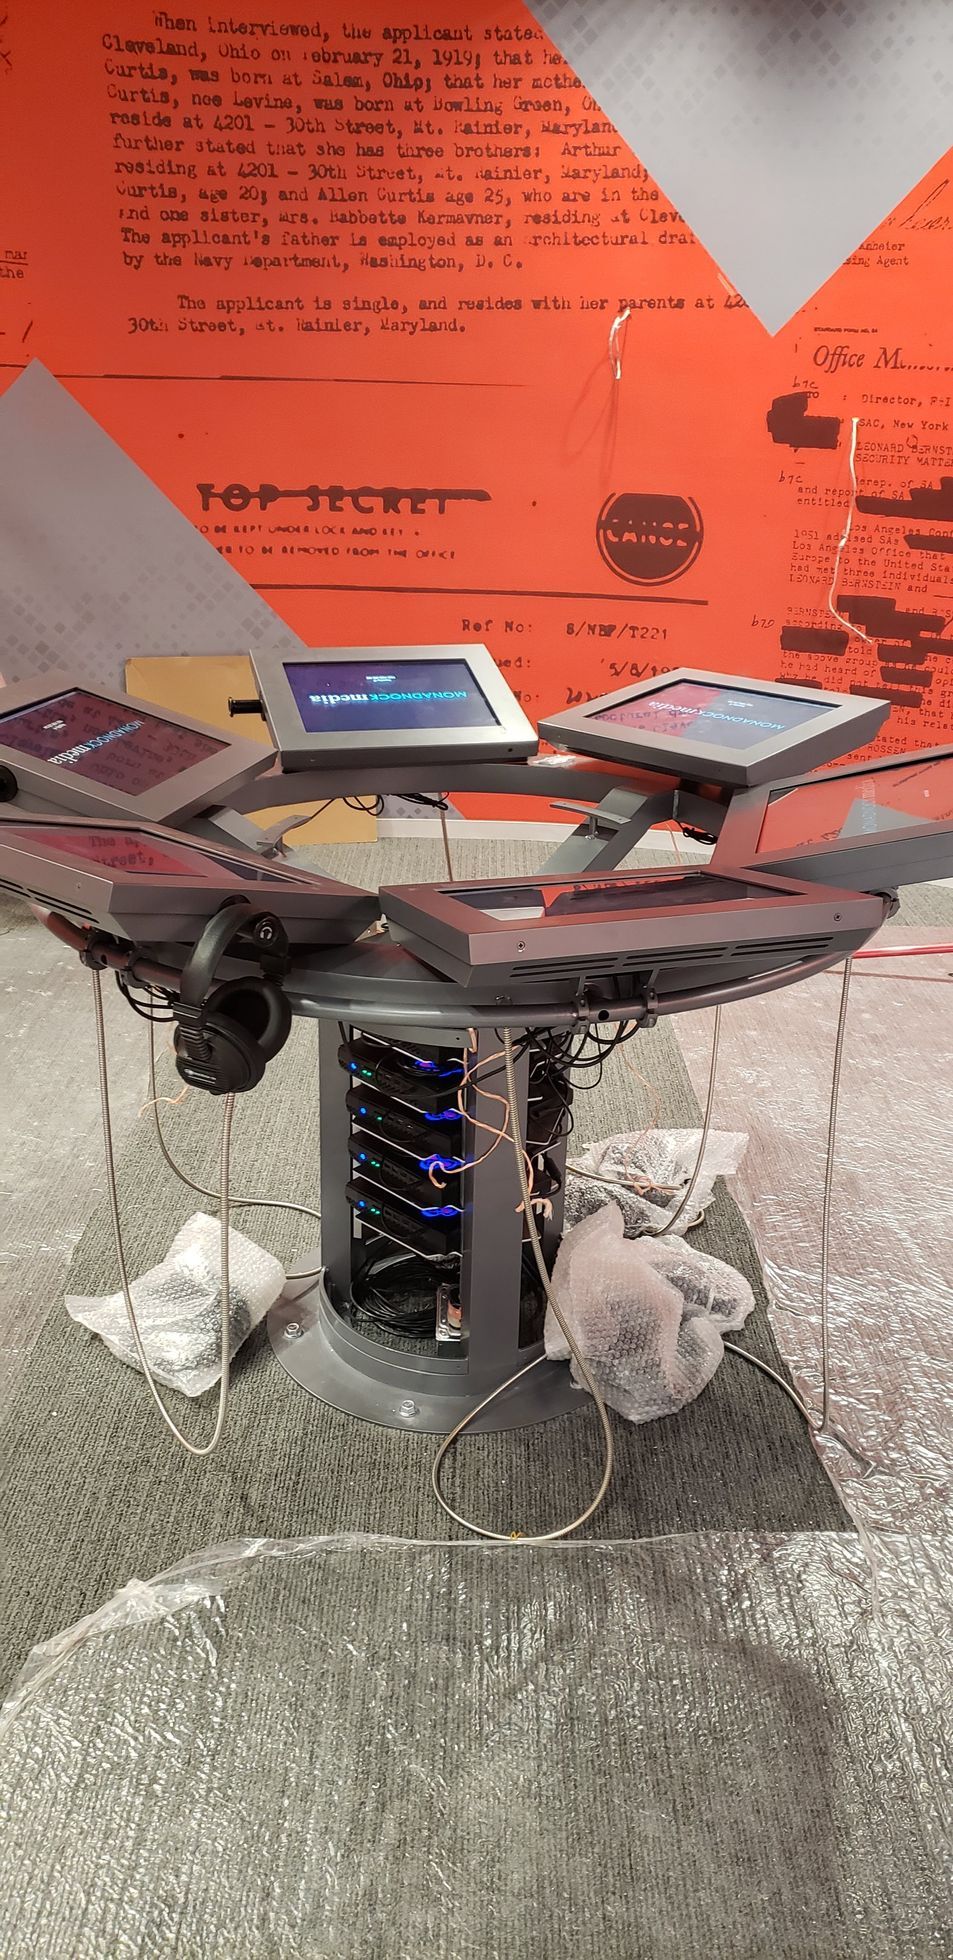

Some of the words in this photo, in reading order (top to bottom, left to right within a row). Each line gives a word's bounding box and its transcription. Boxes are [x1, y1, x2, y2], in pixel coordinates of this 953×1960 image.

[208, 16, 329, 43] interviewed,
[382, 24, 472, 44] applicant
[102, 34, 207, 63] Cleveland,
[219, 43, 261, 60] Ohio
[392, 48, 421, 70] 21,
[432, 49, 480, 70] 1919;
[493, 50, 533, 65] that
[104, 58, 177, 85] Curtis,
[188, 69, 219, 82] was
[231, 67, 272, 85] born
[282, 72, 302, 86] at
[312, 70, 371, 92] Salem,
[444, 73, 484, 89] that
[493, 73, 523, 89] her
[107, 84, 179, 109] Curtis,
[233, 91, 302, 114] Levine,
[313, 99, 343, 111] was
[354, 96, 394, 112] born
[404, 97, 424, 113] at
[433, 96, 503, 116] Bowling
[514, 96, 570, 116] Green,
[109, 111, 171, 127] reside
[183, 114, 203, 130] at
[213, 114, 255, 132] 4201
[286, 117, 326, 134] 30th
[335, 119, 402, 139] Street,
[113, 133, 184, 152] further
[196, 138, 256, 155] stated
[267, 141, 306, 156] that
[316, 141, 345, 156] she
[356, 142, 384, 157] has
[397, 143, 444, 158] three
[453, 143, 539, 158] brothers:
[561, 142, 621, 157] Arthur
[114, 159, 197, 179] residing
[207, 161, 226, 177] at
[237, 162, 279, 179] 4201
[308, 164, 347, 180] 30th
[357, 165, 423, 184] Street,
[116, 181, 186, 203] Curtis,
[239, 185, 267, 206] 20;
[278, 187, 308, 201] and
[318, 187, 368, 202] Allen
[377, 187, 435, 203] Curtis
[445, 192, 473, 206] age
[485, 188, 511, 207] 25,
[521, 188, 552, 202] who
[562, 191, 590, 202] are
[601, 188, 621, 202] in
[631, 187, 659, 201] the
[200, 208, 268, 228] sister,
[524, 209, 600, 227] residing
[121, 227, 150, 244] The
[161, 229, 270, 248] applicant's
[281, 232, 339, 246] father
[349, 233, 367, 246] is
[378, 232, 456, 250] employed
[465, 236, 483, 246] as
[493, 236, 512, 246] an
[122, 251, 144, 270] by
[154, 252, 182, 266] the
[503, 254, 522, 269] C.
[877, 256, 909, 268] Agent
[177, 295, 206, 309] The
[216, 296, 304, 314] applicant
[313, 296, 332, 310] is
[342, 296, 407, 314] single,
[419, 296, 447, 310] and
[458, 296, 522, 310] resides
[531, 296, 571, 310] with
[580, 296, 608, 310] her
[617, 296, 685, 314] parents
[695, 298, 714, 309] at
[178, 317, 245, 336] Street,
[380, 317, 465, 335] Maryland.
[813, 345, 866, 373] Office
[893, 419, 914, 428] New
[921, 420, 949, 431] York
[196, 484, 280, 511] TOP
[306, 485, 446, 515] SECRET
[798, 486, 818, 494] and
[883, 560, 924, 571] United
[907, 584, 928, 593] and
[461, 619, 493, 632] Ref
[504, 620, 532, 633] No:
